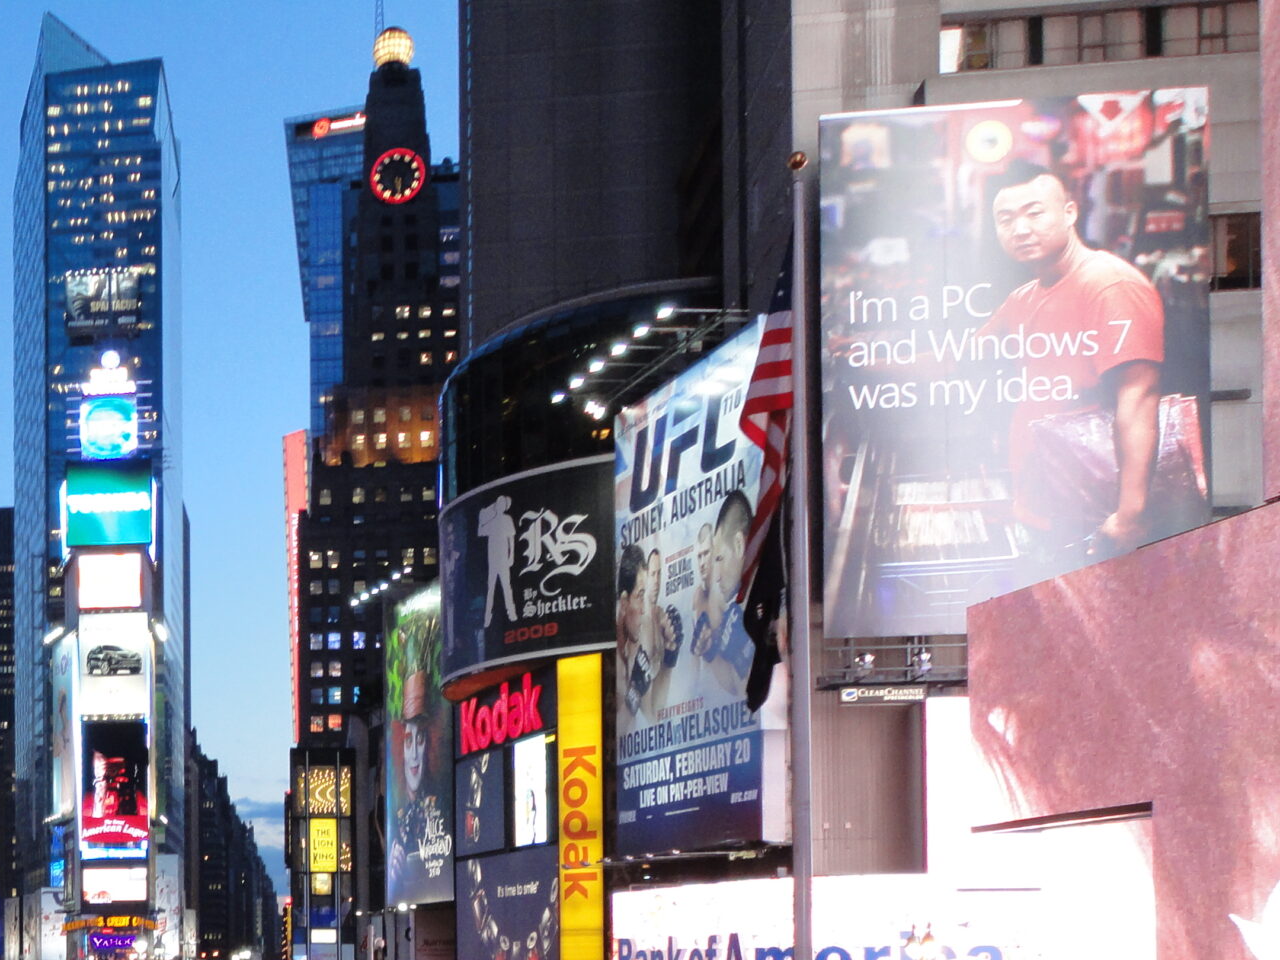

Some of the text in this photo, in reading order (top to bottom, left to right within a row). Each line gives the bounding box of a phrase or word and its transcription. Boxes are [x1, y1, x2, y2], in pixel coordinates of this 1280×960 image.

[848, 283, 992, 324] I'm a PC
[848, 319, 1132, 367] and Windows 7
[848, 367, 1079, 415] was my idea.
[630, 393, 737, 514] UFC
[621, 460, 747, 550] SYDNEY, AUSTRALIA
[523, 587, 538, 600] By
[665, 570, 695, 597] BISPING
[460, 672, 544, 756] Kodak
[619, 721, 673, 760] NOGUEIRA
[623, 738, 751, 791] SATURDAY, FEBRUARY 20
[639, 772, 729, 809] LIVE ON PAY-PER-VIEW
[316, 828, 331, 836] THE
[562, 745, 598, 900] Kodak
